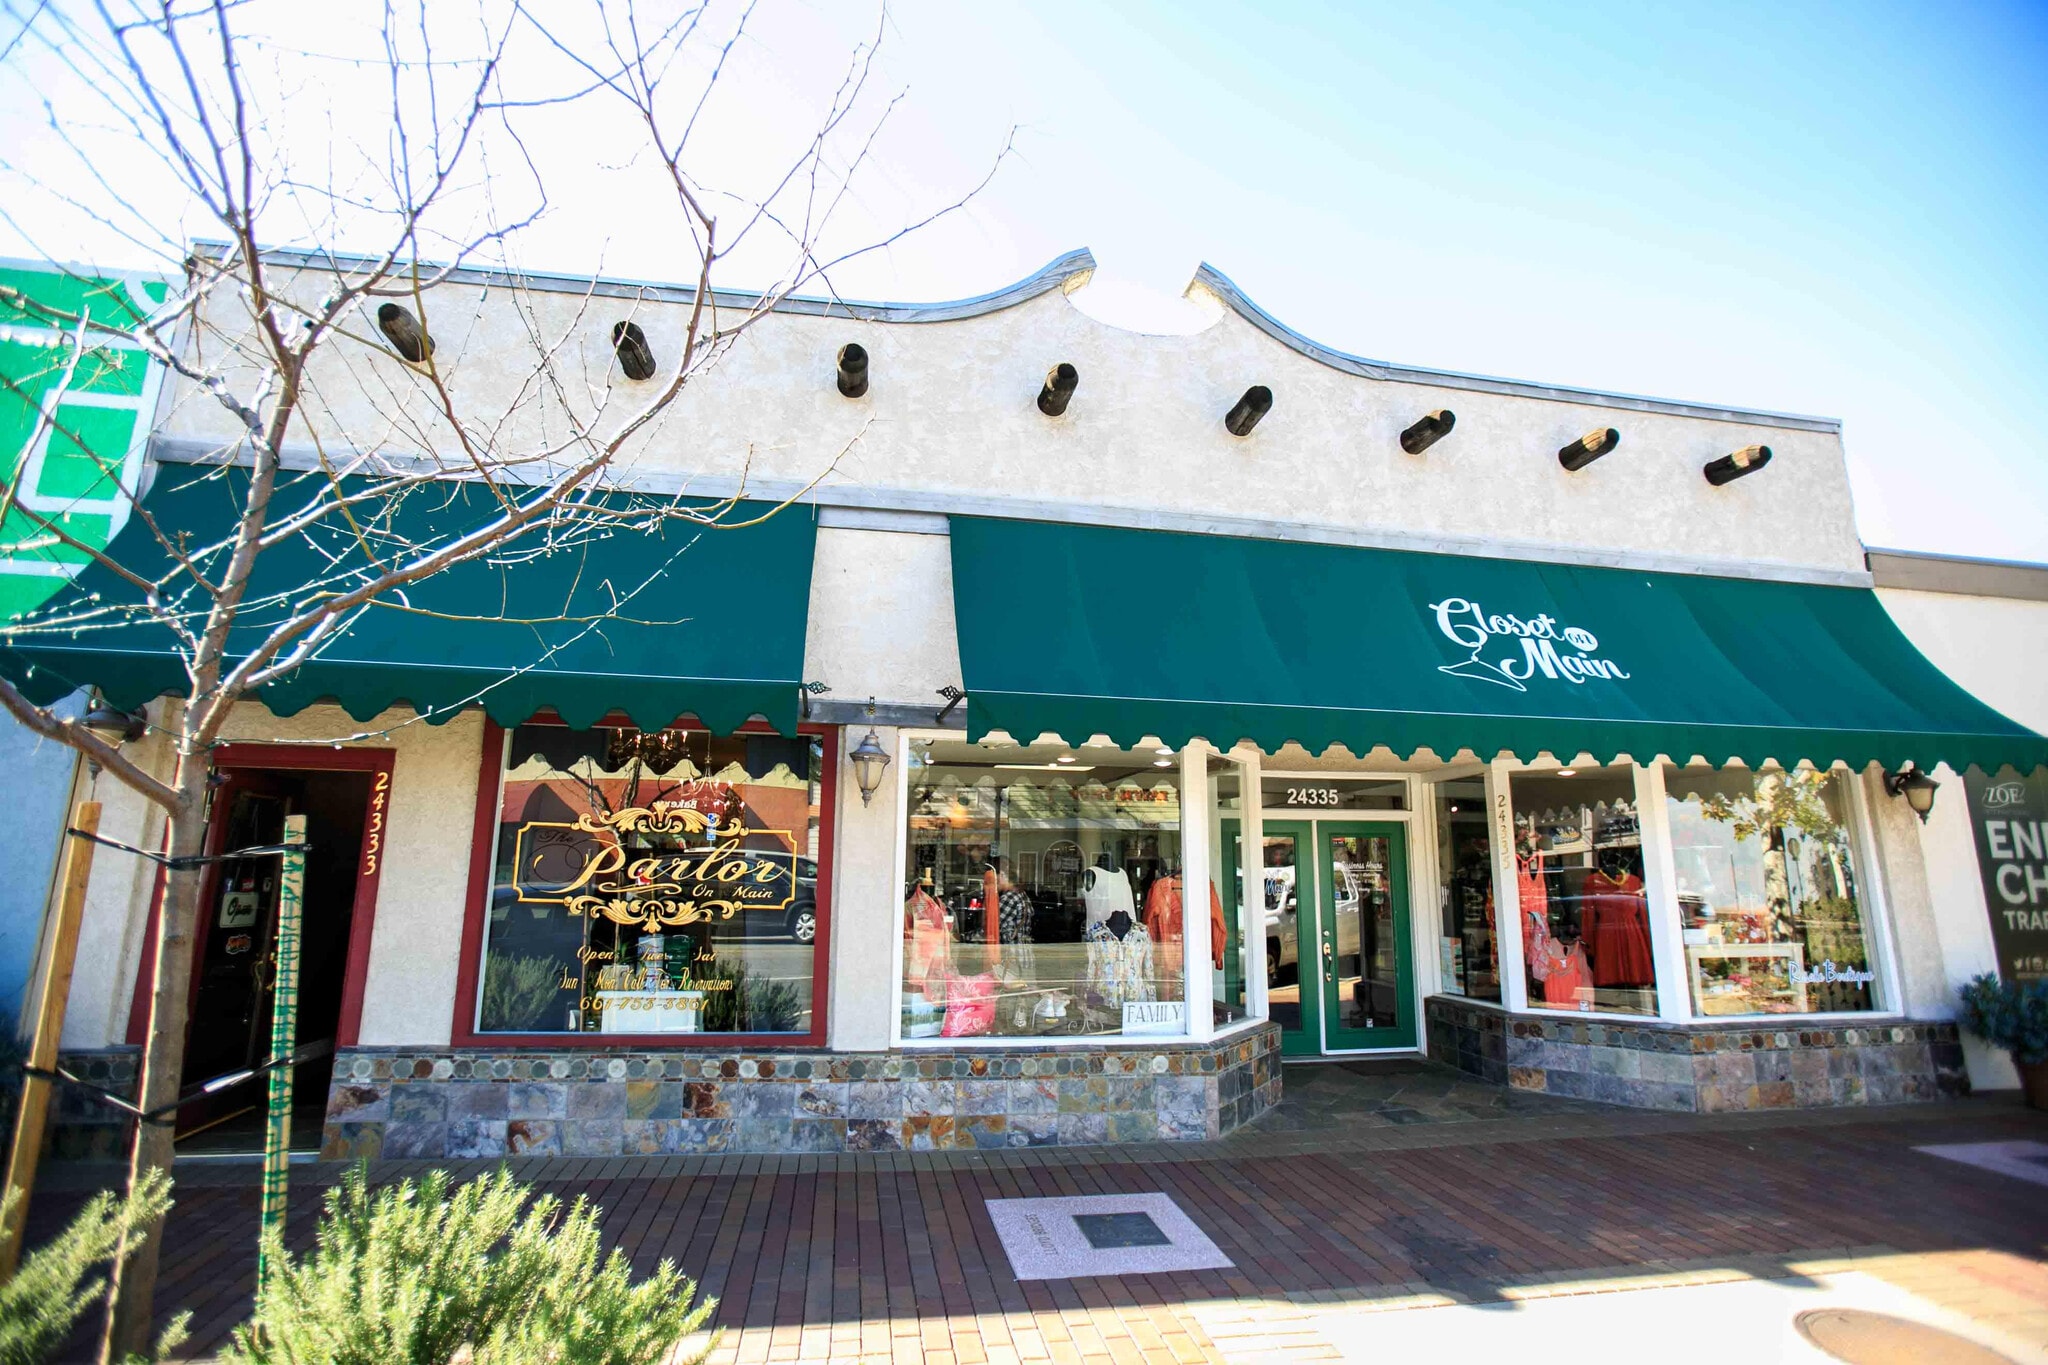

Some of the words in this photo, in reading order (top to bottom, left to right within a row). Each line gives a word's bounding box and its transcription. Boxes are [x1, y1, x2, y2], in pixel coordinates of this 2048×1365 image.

[1428, 598, 1565, 648] Closet
[1500, 637, 1631, 684] Main
[1287, 788, 1339, 804] 24335
[1985, 787, 2025, 804] ZOE
[363, 772, 389, 876] 24333
[537, 828, 574, 843] The
[1985, 820, 2048, 859] EN
[524, 838, 787, 894] Parlor
[692, 884, 714, 898] On
[732, 885, 775, 899] Main
[227, 896, 253, 924] Open
[693, 946, 717, 962] Sat
[560, 966, 579, 990] Sun
[594, 968, 616, 991] Mon
[623, 966, 648, 991] Call
[678, 966, 733, 992] Reservations
[1822, 959, 1875, 991] Boutique
[1127, 1004, 1183, 1023] FAMILY
